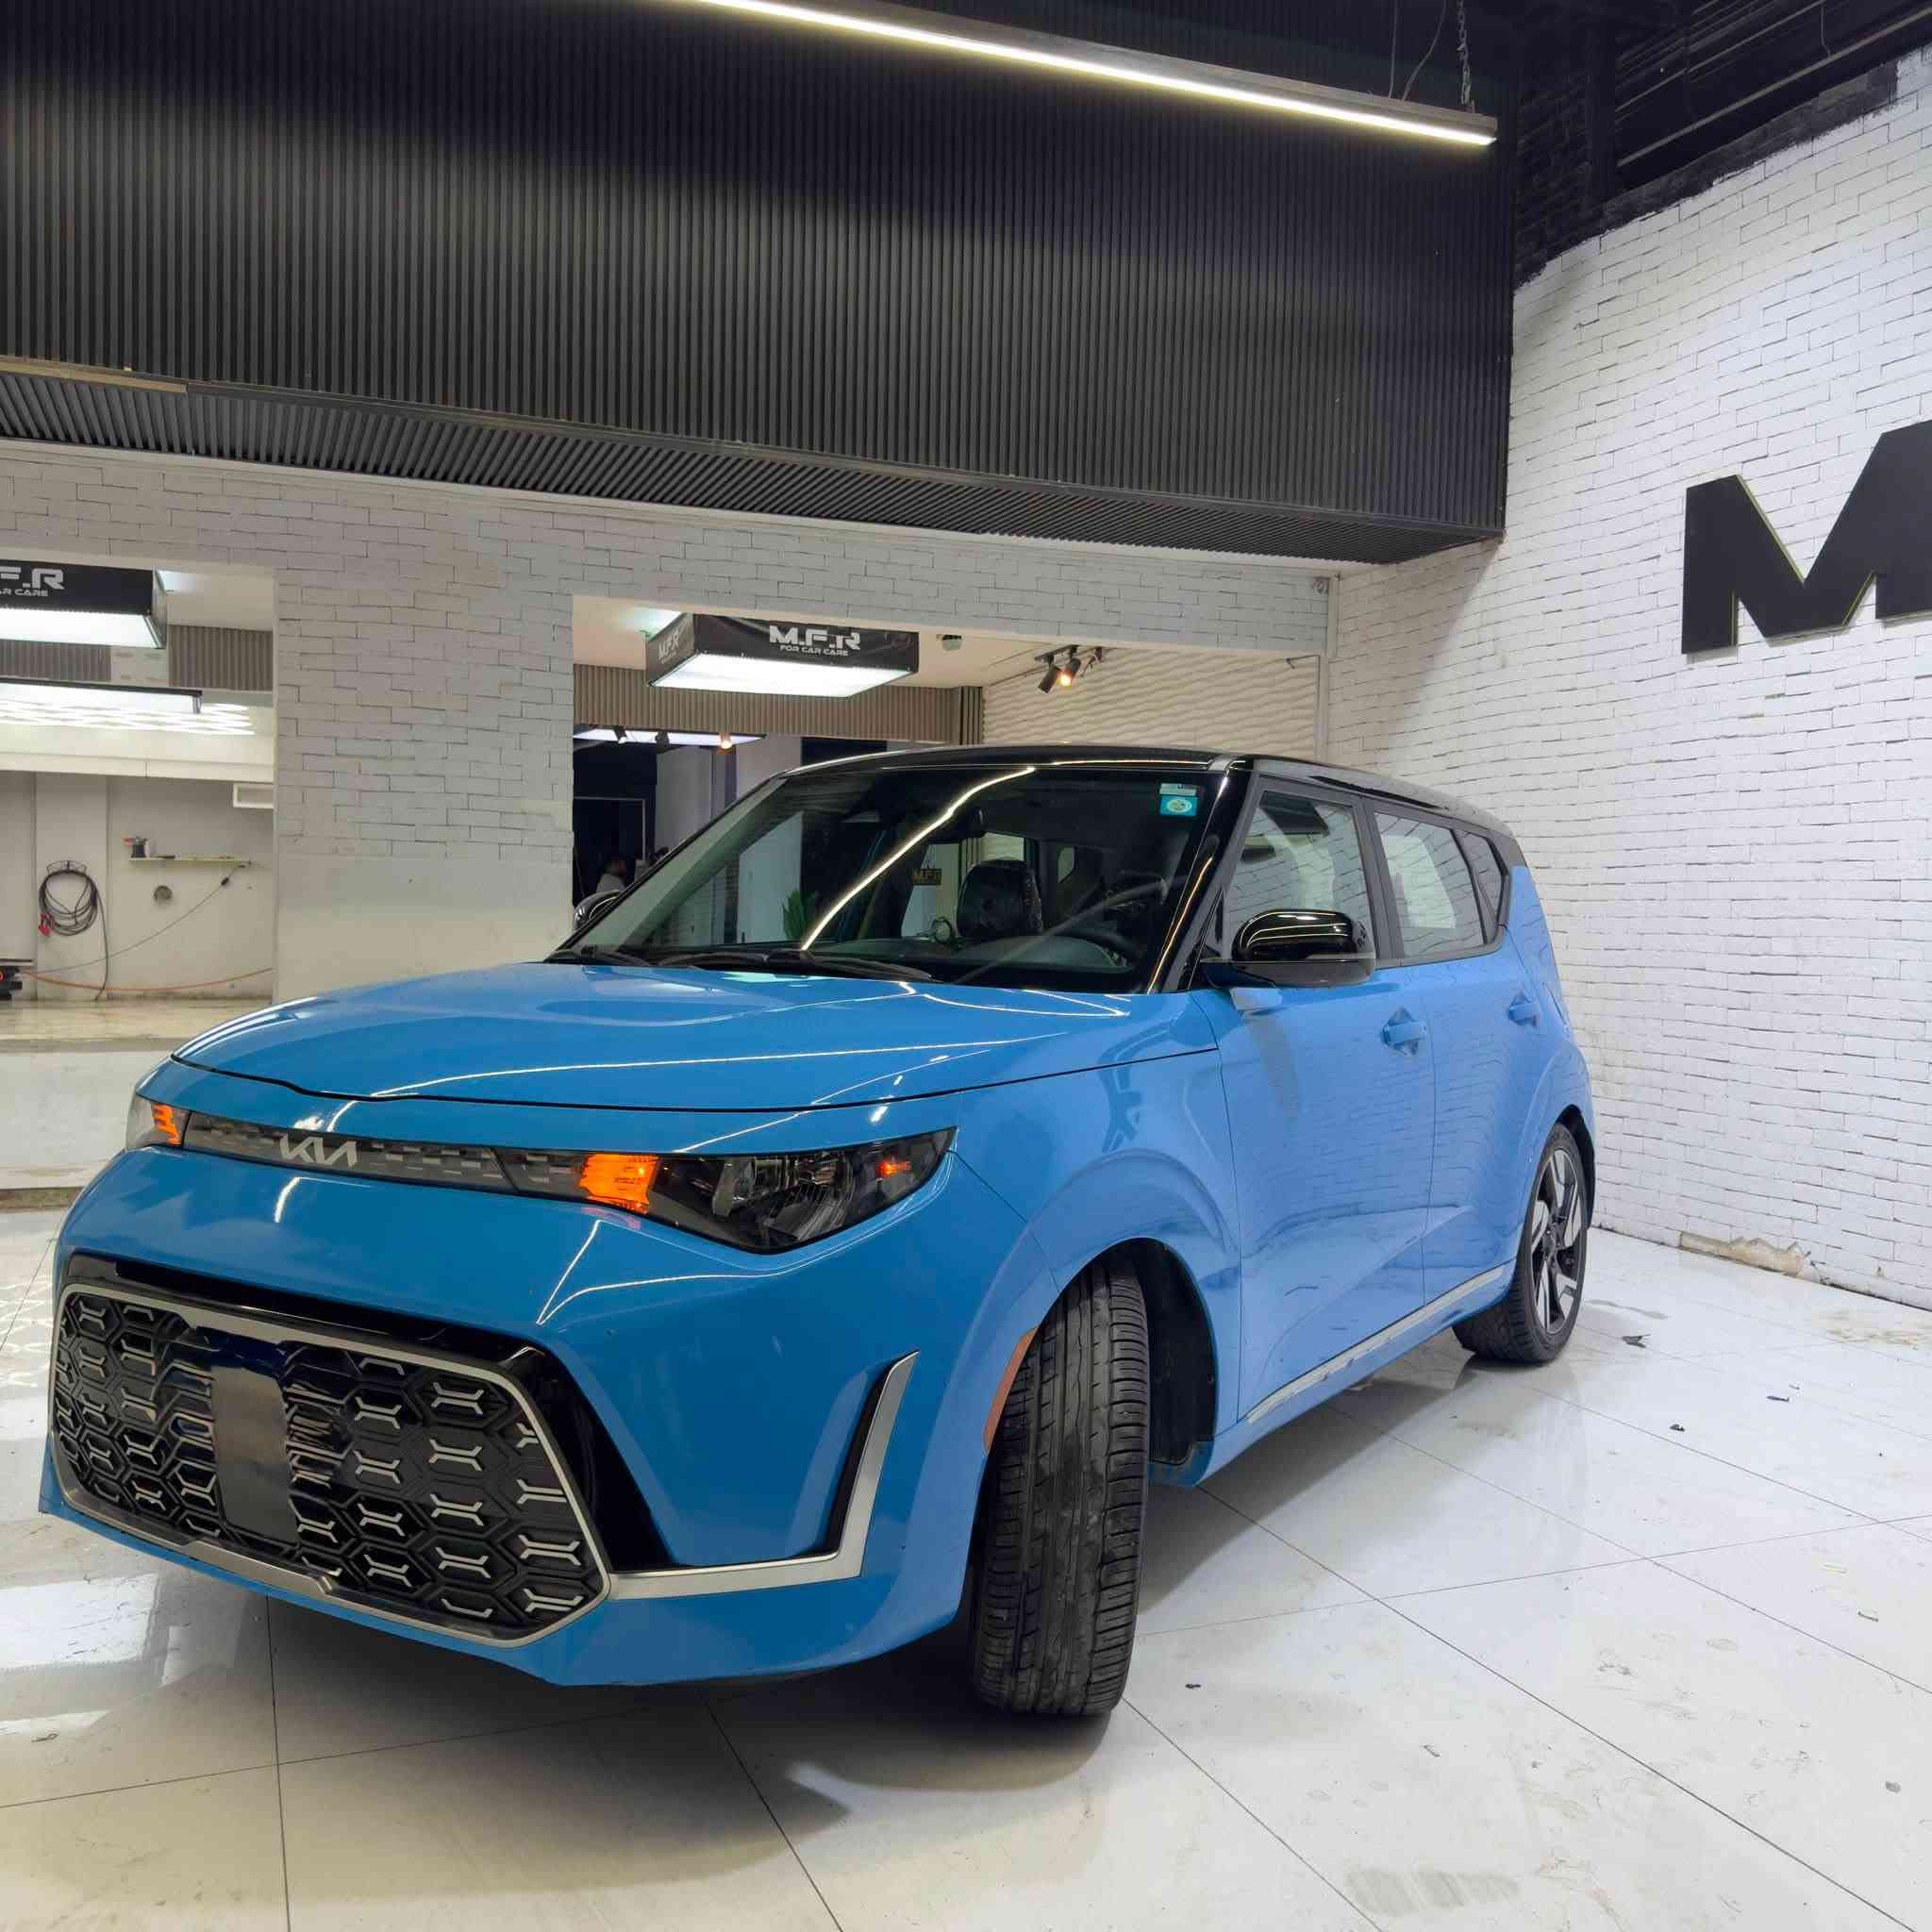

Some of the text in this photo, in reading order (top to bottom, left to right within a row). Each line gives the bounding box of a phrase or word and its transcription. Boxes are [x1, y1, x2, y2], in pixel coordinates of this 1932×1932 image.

[1681, 419, 1932, 655] M
[14, 589, 49, 597] CARE
[769, 625, 860, 651] M.F.R
[801, 646, 822, 655] CAR
[823, 648, 849, 657] CARE
[279, 1132, 358, 1168] KIA
